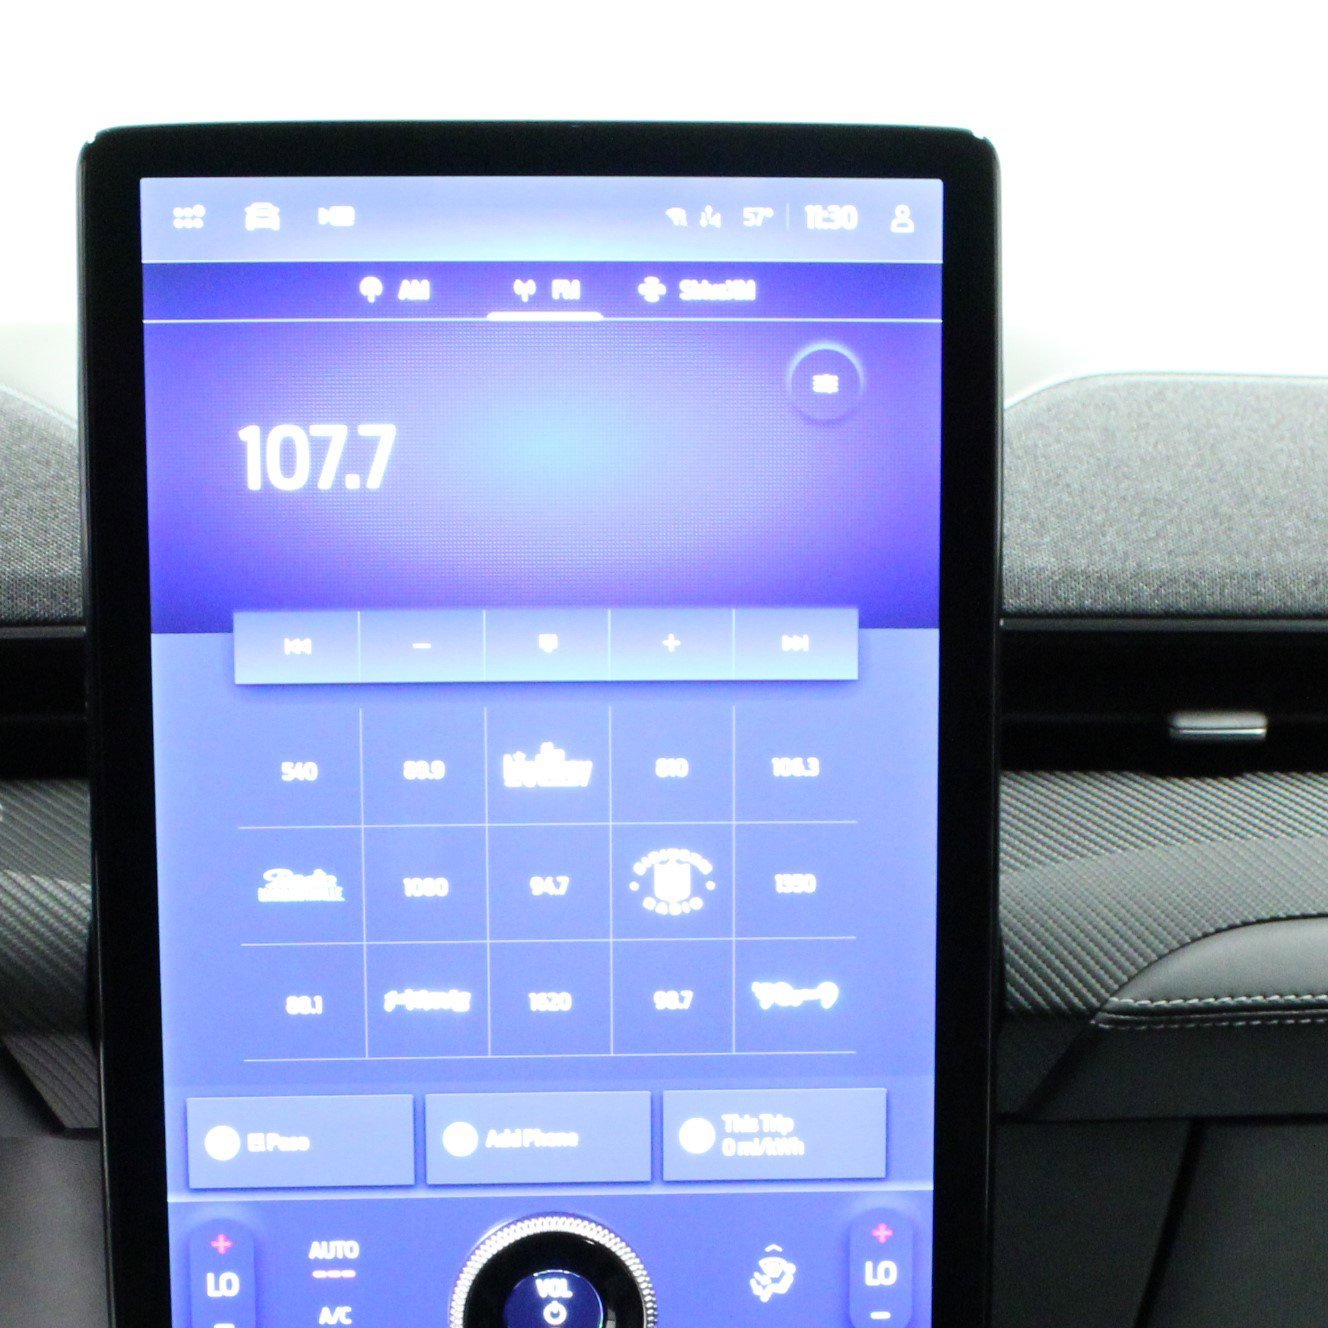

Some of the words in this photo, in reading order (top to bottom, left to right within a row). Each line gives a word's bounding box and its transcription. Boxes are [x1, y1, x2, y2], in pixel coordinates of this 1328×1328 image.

[804, 204, 859, 230] 11:30
[397, 279, 430, 301] AM
[551, 279, 580, 300] FM
[238, 423, 397, 491] 107.7
[721, 1113, 759, 1134] This
[759, 1113, 794, 1135] Trip
[247, 1132, 266, 1152] El
[267, 1132, 311, 1152] Paso
[485, 1129, 522, 1148] Add
[523, 1128, 579, 1148] Phone
[308, 1240, 360, 1260] AUTO
[865, 1260, 898, 1287] LO
[206, 1271, 240, 1298] LO
[535, 1278, 573, 1298] VOL
[318, 1305, 353, 1325] A/C
